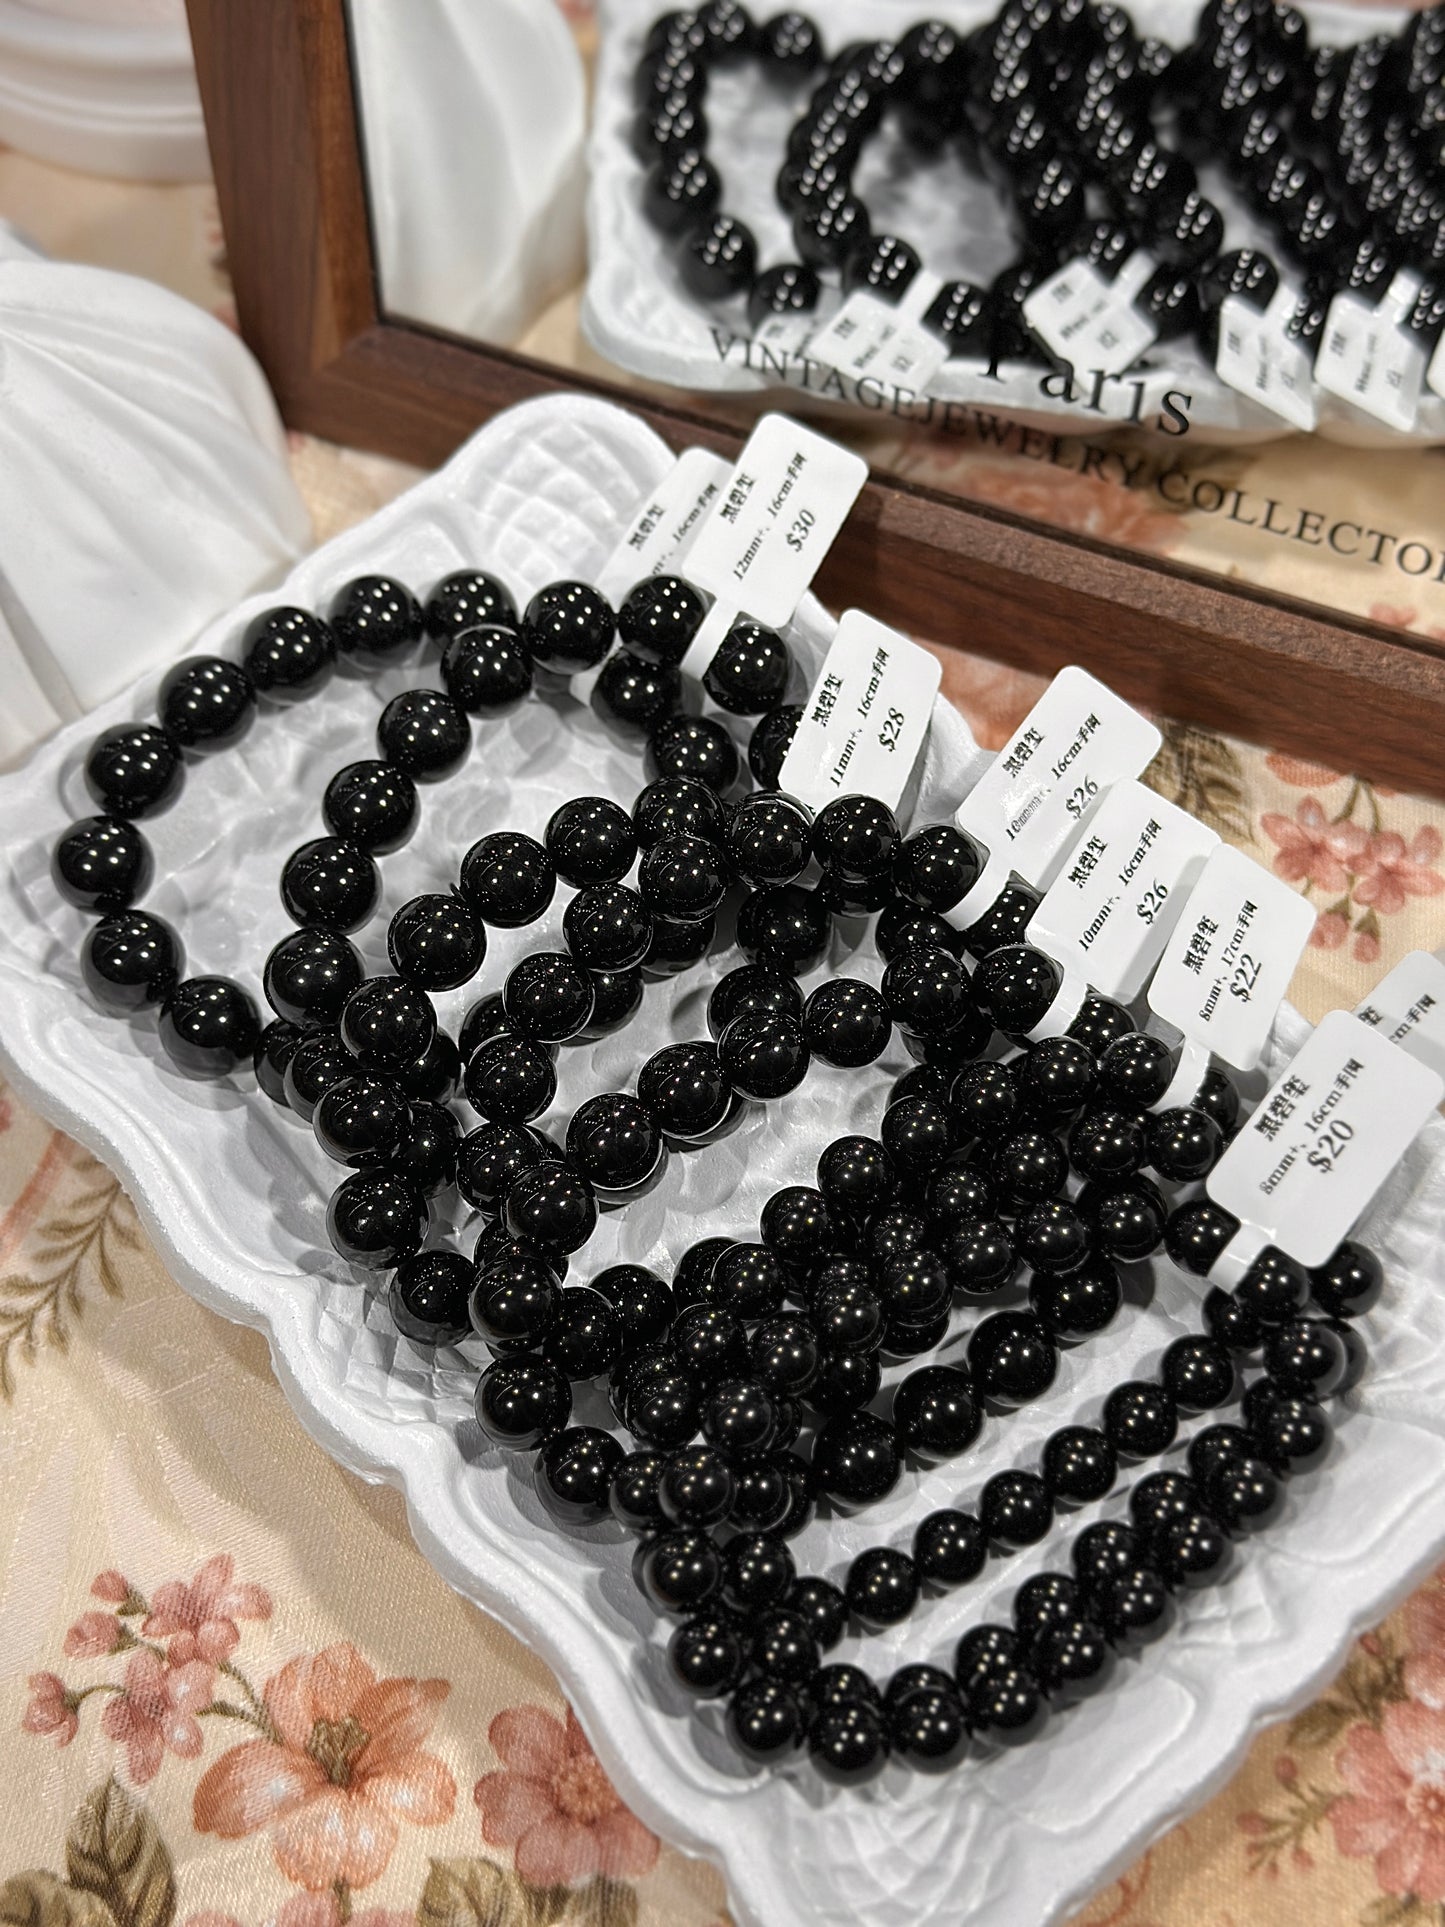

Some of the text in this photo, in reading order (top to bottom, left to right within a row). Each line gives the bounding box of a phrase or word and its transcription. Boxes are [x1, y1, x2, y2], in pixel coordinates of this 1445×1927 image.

[785, 508, 816, 553] $30
[877, 707, 905, 753] $28
[1065, 773, 1099, 820] $26
[1135, 875, 1169, 926] $26
[1229, 953, 1263, 1003] $22
[1306, 1118, 1355, 1175] $20
